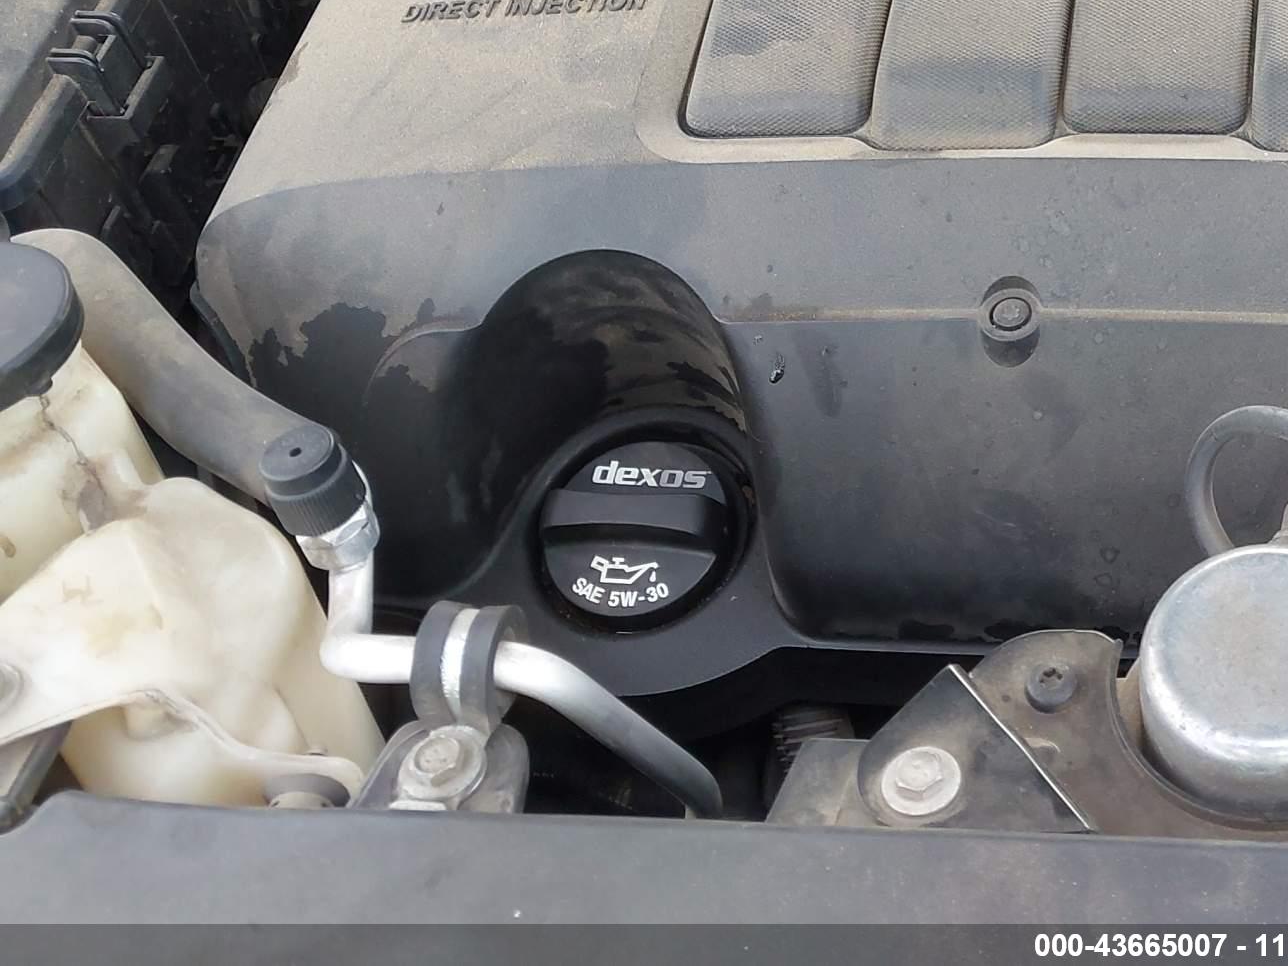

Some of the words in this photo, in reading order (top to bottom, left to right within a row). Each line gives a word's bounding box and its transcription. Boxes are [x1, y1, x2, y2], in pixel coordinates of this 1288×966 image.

[592, 460, 707, 489] dexos
[572, 577, 606, 604] SAE
[608, 582, 669, 608] 5W-30
